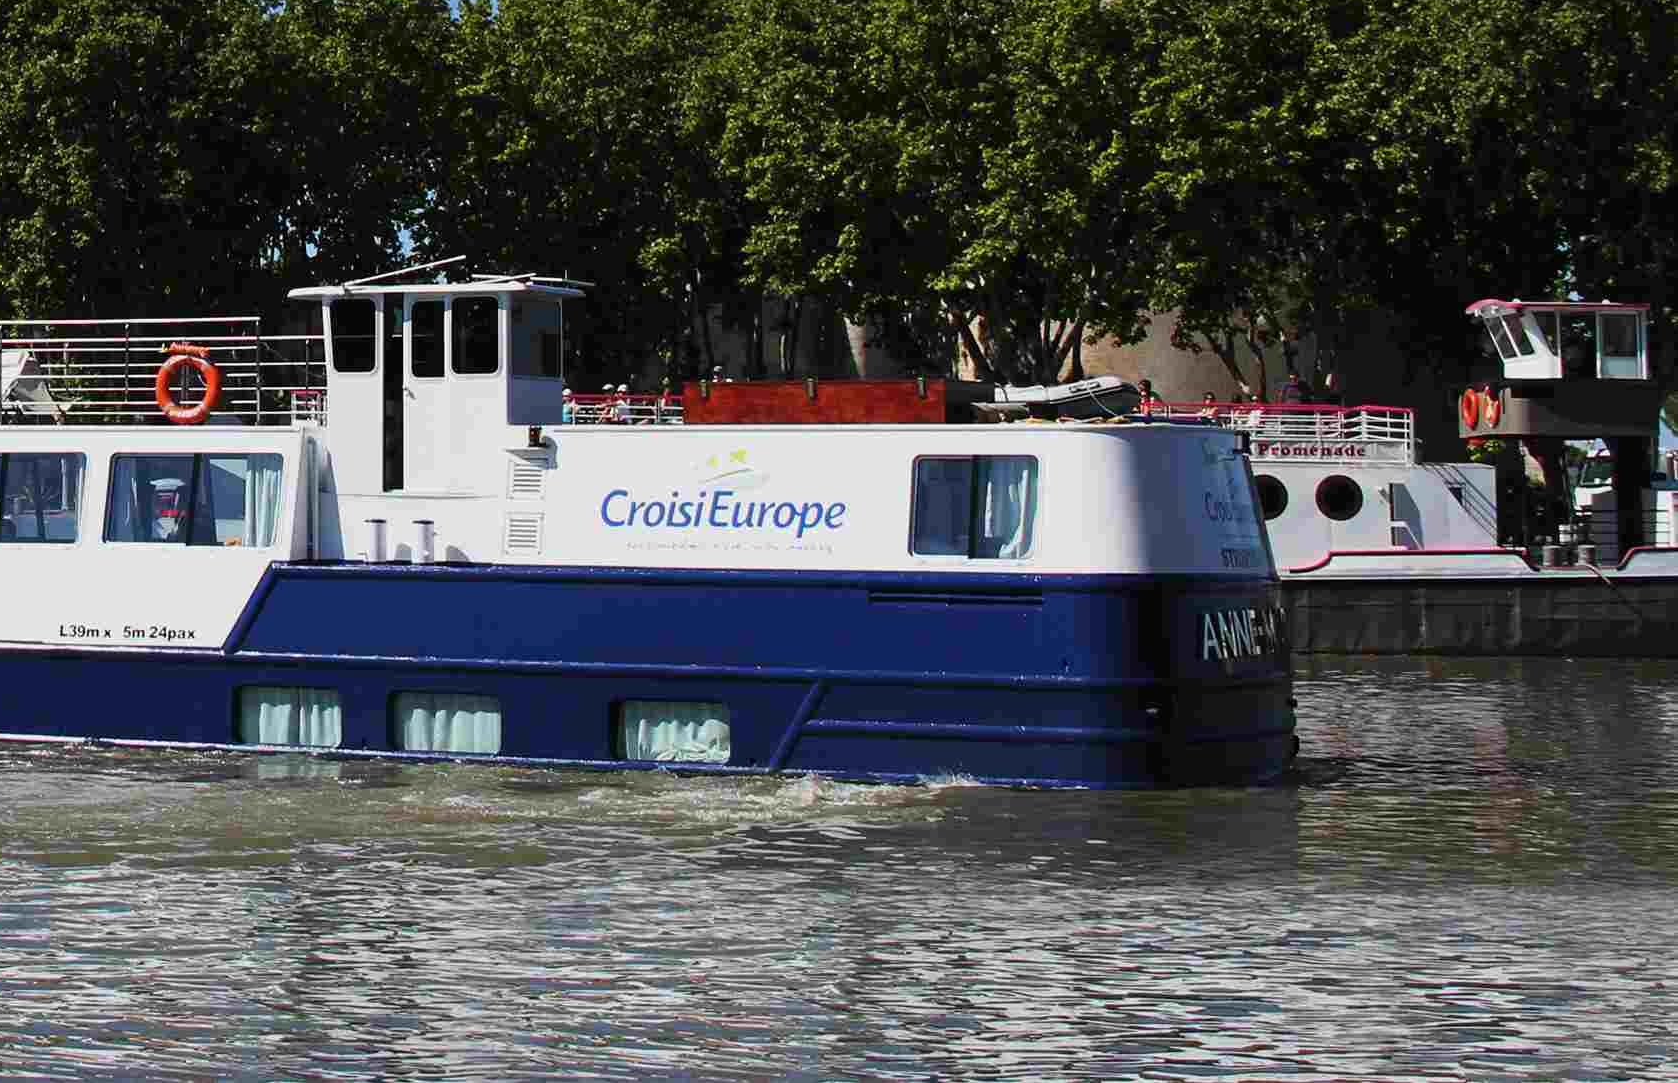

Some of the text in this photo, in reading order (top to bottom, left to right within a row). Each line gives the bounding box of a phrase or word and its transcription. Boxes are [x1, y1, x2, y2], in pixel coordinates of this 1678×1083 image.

[1257, 443, 1366, 457] Promenade
[600, 489, 846, 538] CroisiEurope
[59, 624, 100, 638] L39m
[149, 625, 195, 641] 24pax
